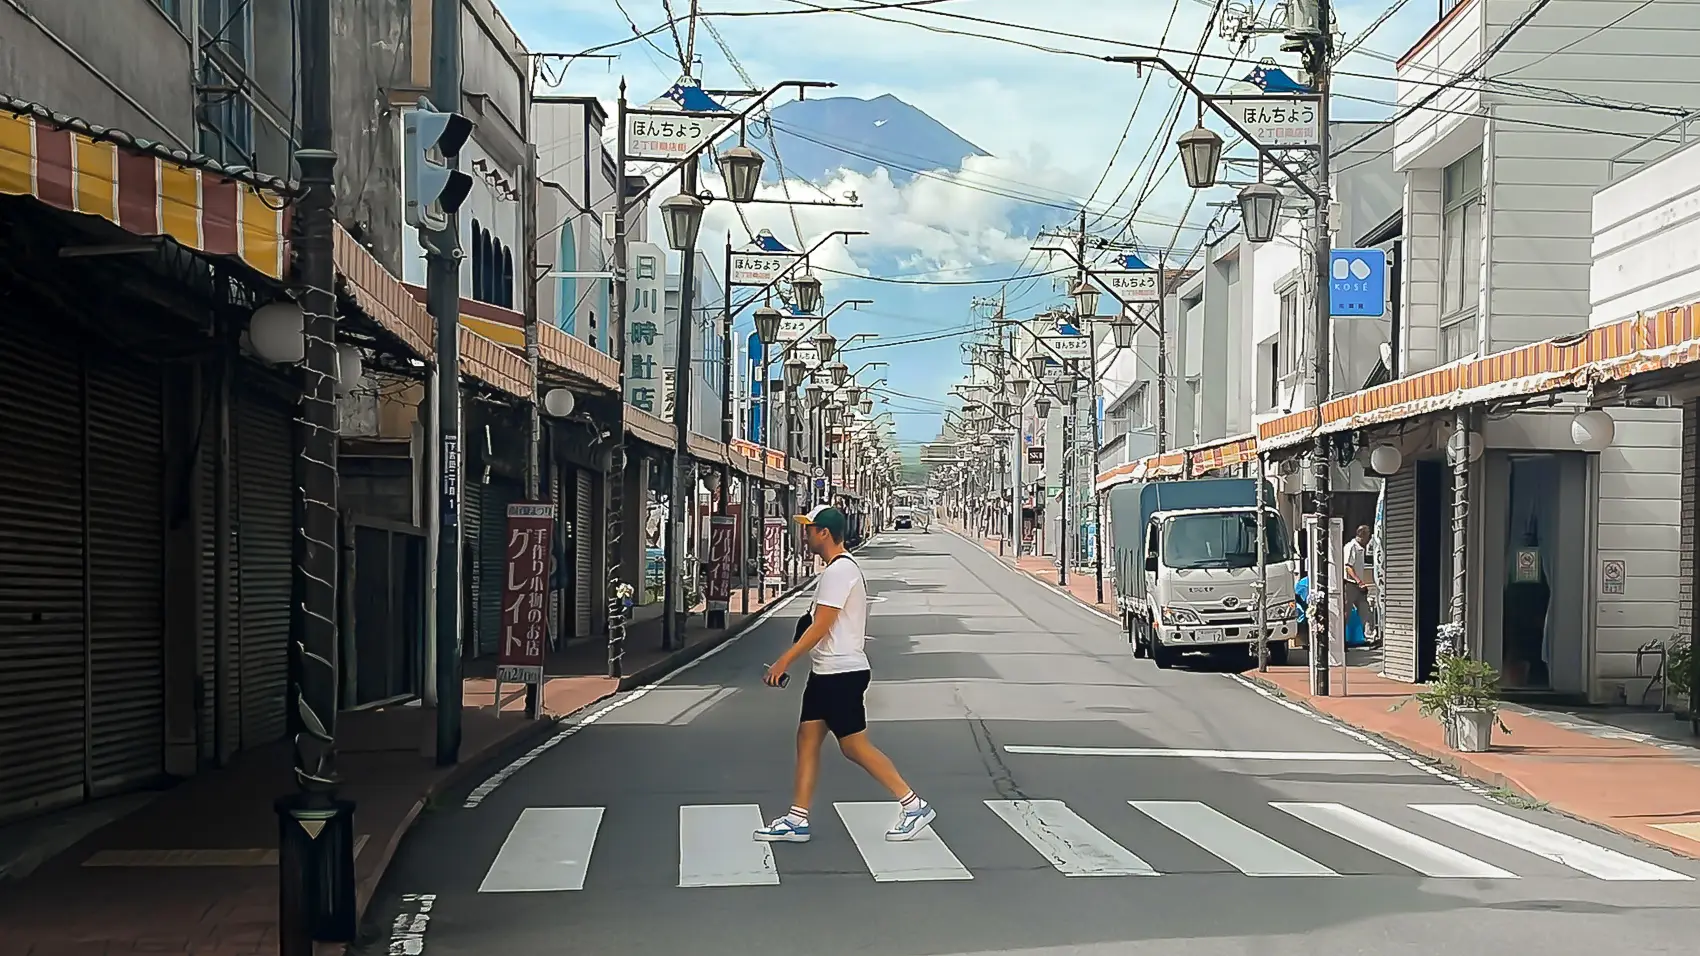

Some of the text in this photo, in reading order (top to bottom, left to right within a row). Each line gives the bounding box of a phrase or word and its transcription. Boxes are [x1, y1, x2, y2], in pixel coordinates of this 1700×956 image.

[1244, 106, 1314, 124] ほんちょう
[633, 120, 702, 139] ほんちょう
[735, 259, 781, 271] ほんちょう
[1112, 276, 1155, 288] ほんちょう
[1333, 281, 1369, 292] KOSÉ
[632, 255, 657, 412] 日川時計店
[503, 528, 533, 656] グレイト
[525, 528, 548, 656] 手作り小物のお店
